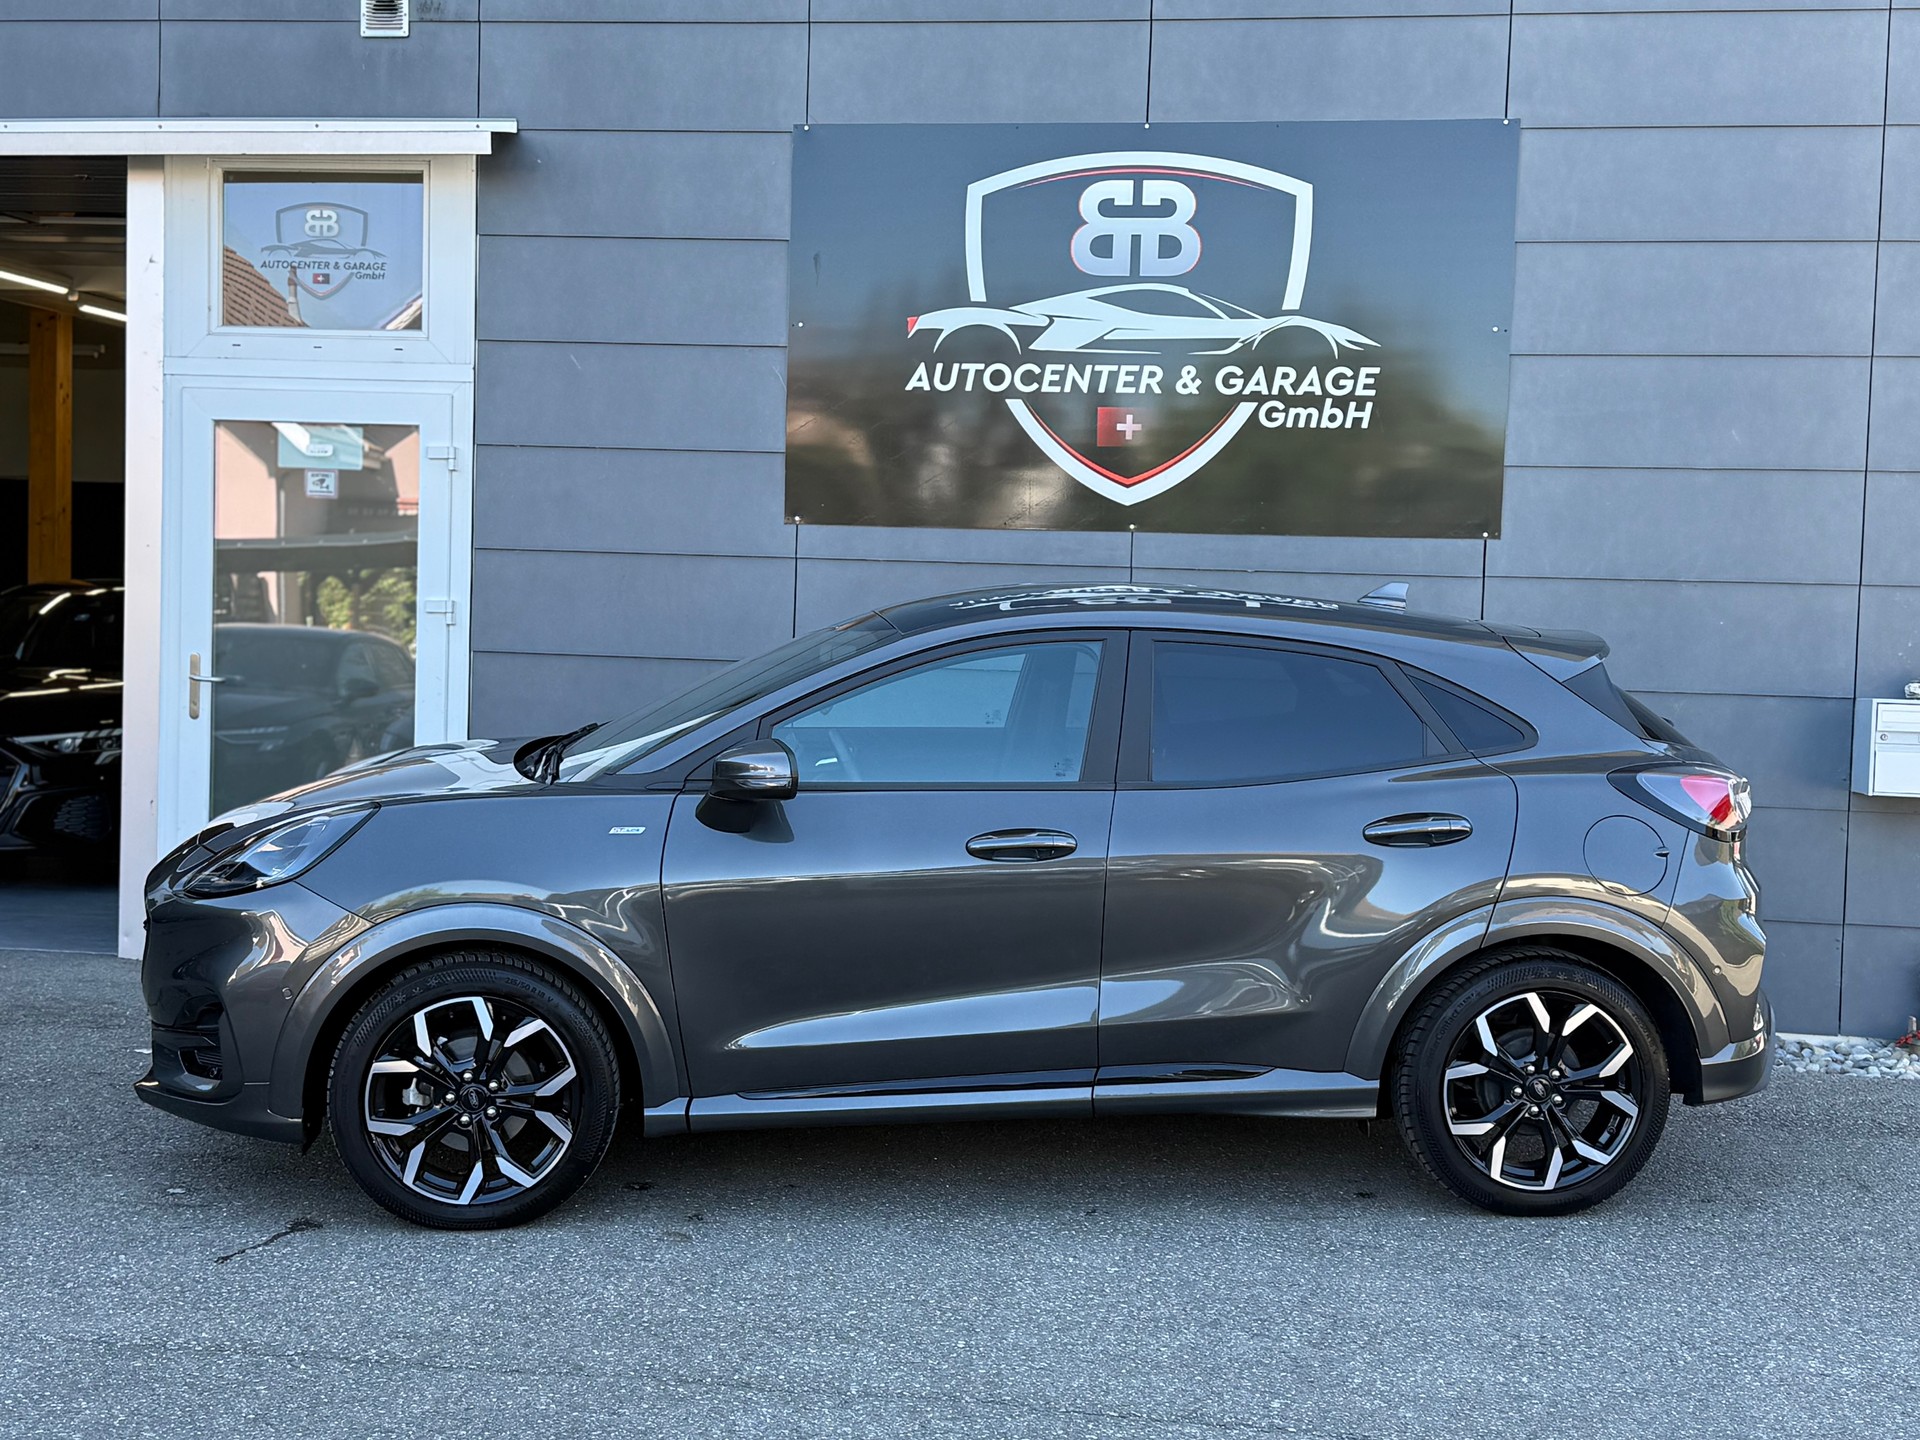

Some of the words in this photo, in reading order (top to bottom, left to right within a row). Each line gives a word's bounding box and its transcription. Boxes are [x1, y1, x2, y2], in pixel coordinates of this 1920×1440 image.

[260, 260, 330, 270] AUTOCENTER
[333, 261, 341, 270] &
[343, 262, 387, 271] GARAGE
[355, 271, 385, 280] GmbH
[904, 361, 1163, 395] AUTOCENTER
[1175, 364, 1202, 395] &
[1214, 365, 1381, 397] GARAGE
[1258, 398, 1374, 429] GmbH
